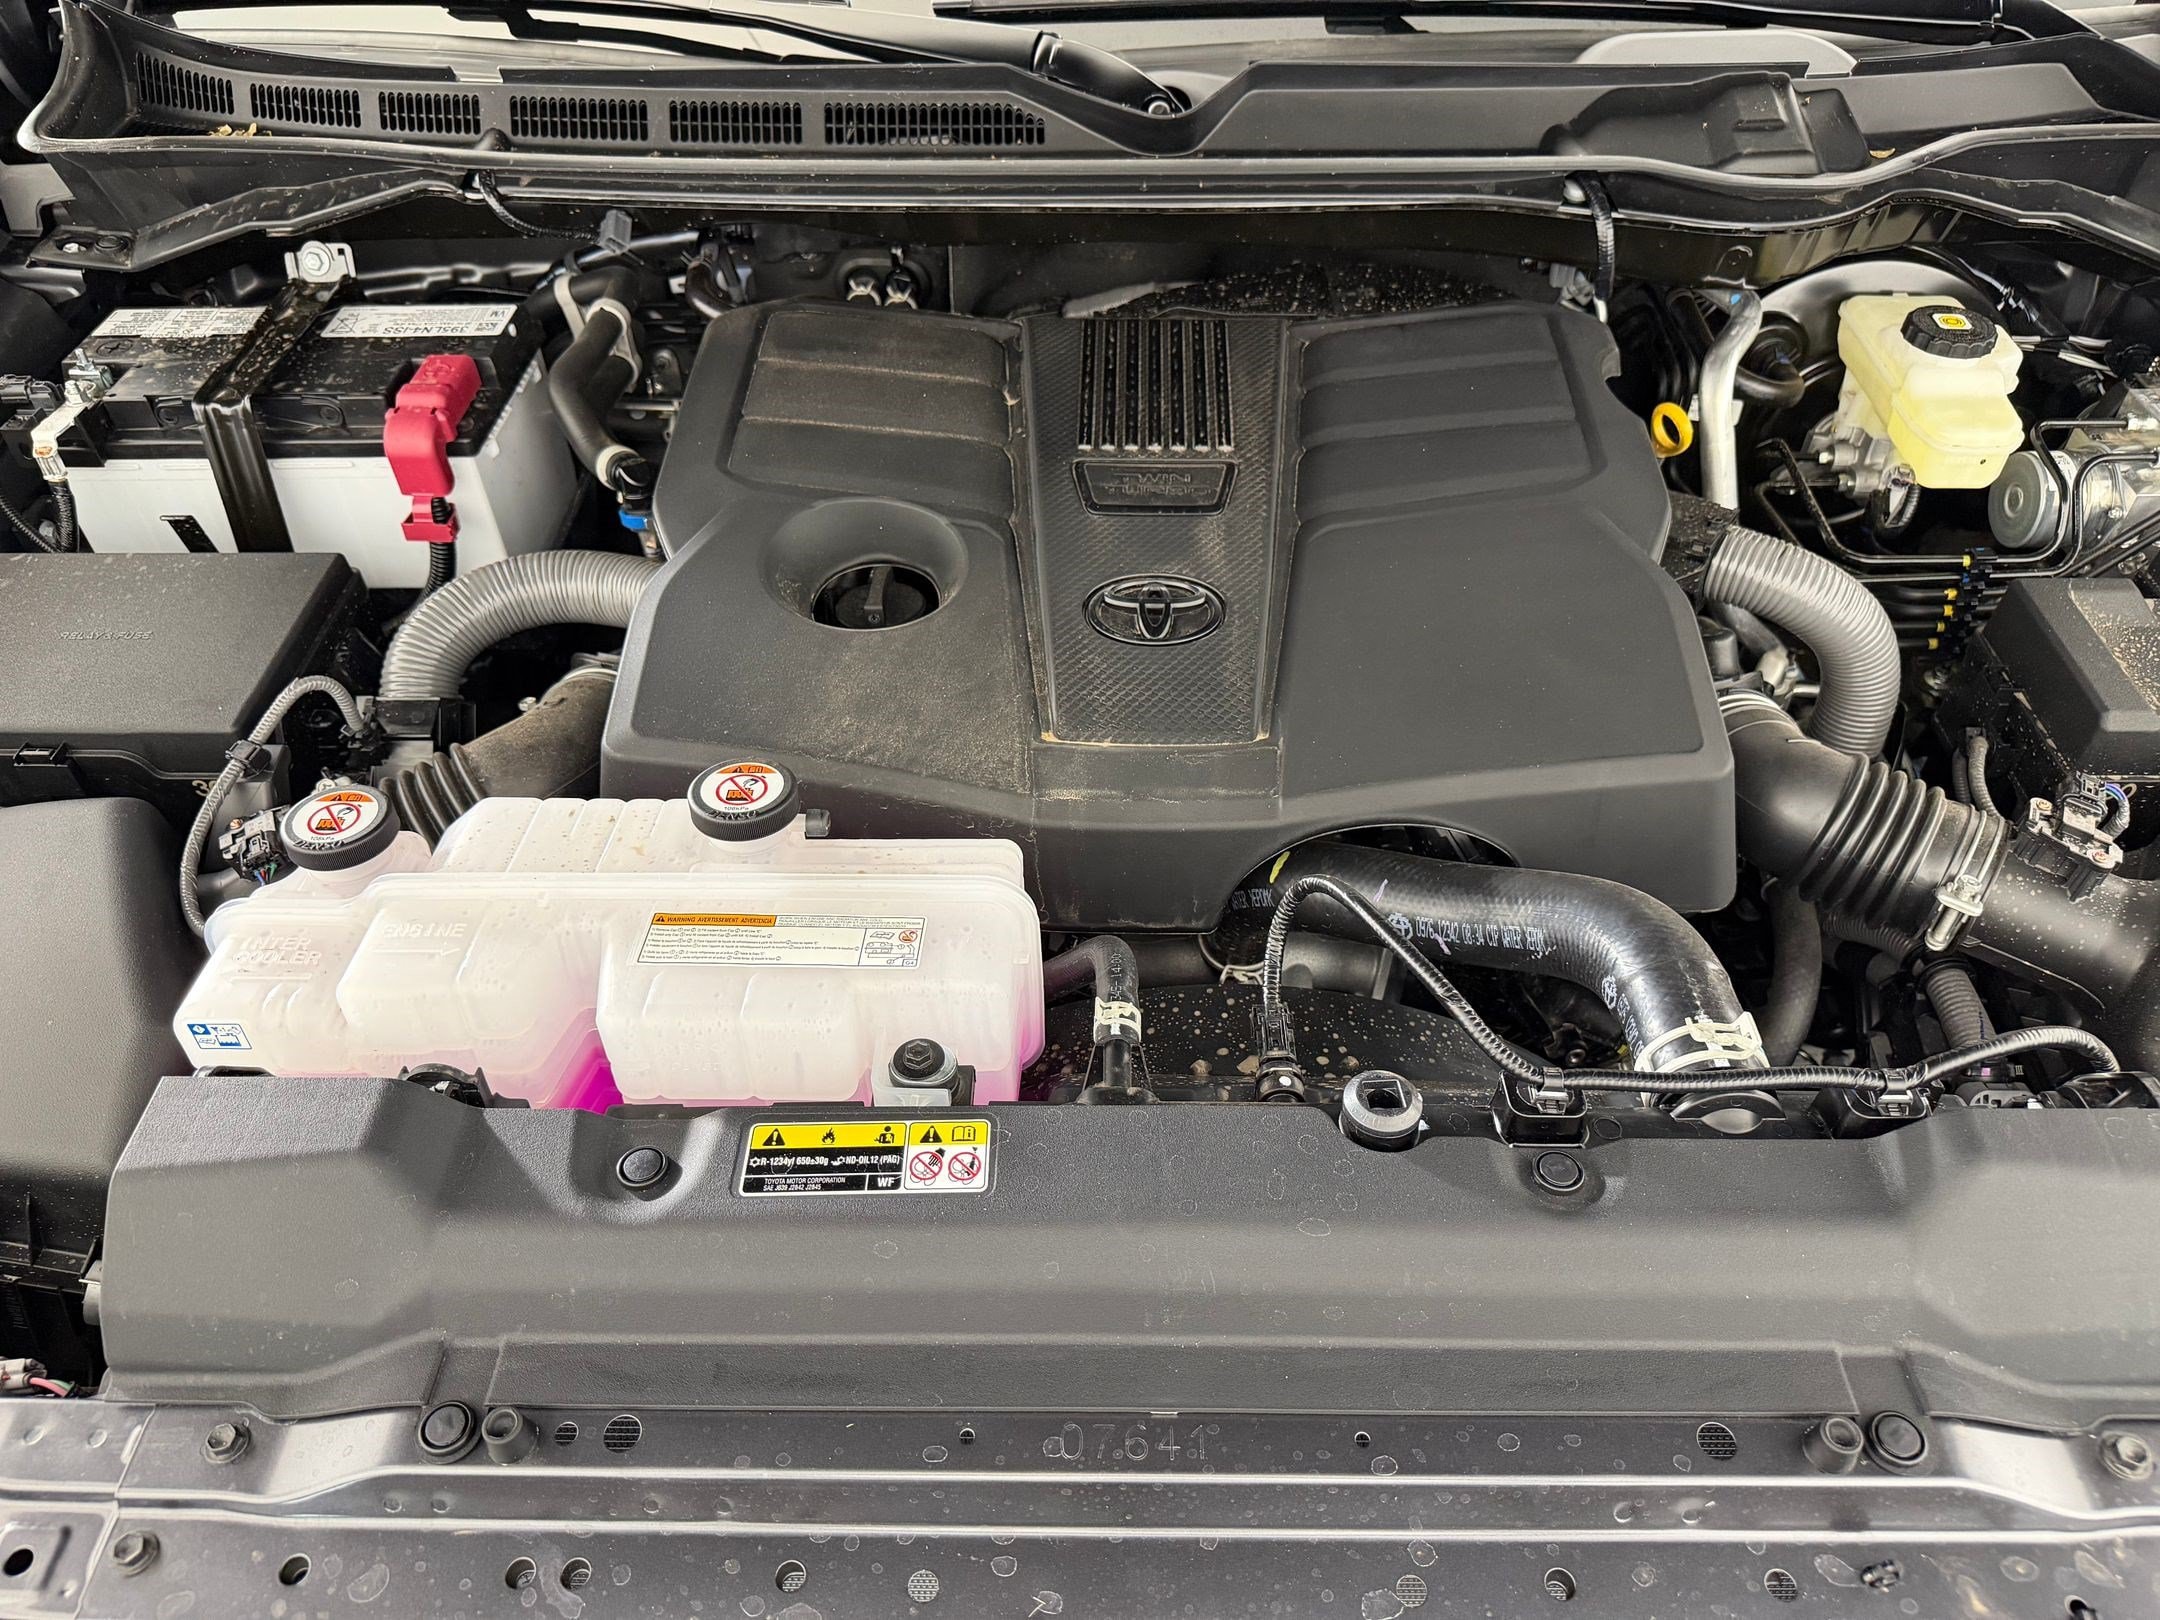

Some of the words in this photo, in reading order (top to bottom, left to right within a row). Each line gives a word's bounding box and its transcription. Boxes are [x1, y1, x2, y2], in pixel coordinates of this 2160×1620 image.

[116, 631, 153, 640] FUSE
[383, 923, 467, 938] ENGINE
[240, 936, 312, 950] INTER
[233, 951, 322, 965] COOLER
[880, 1154, 900, 1165] (PAG)
[807, 1176, 846, 1184] CORPORATION
[877, 1177, 895, 1187] WF
